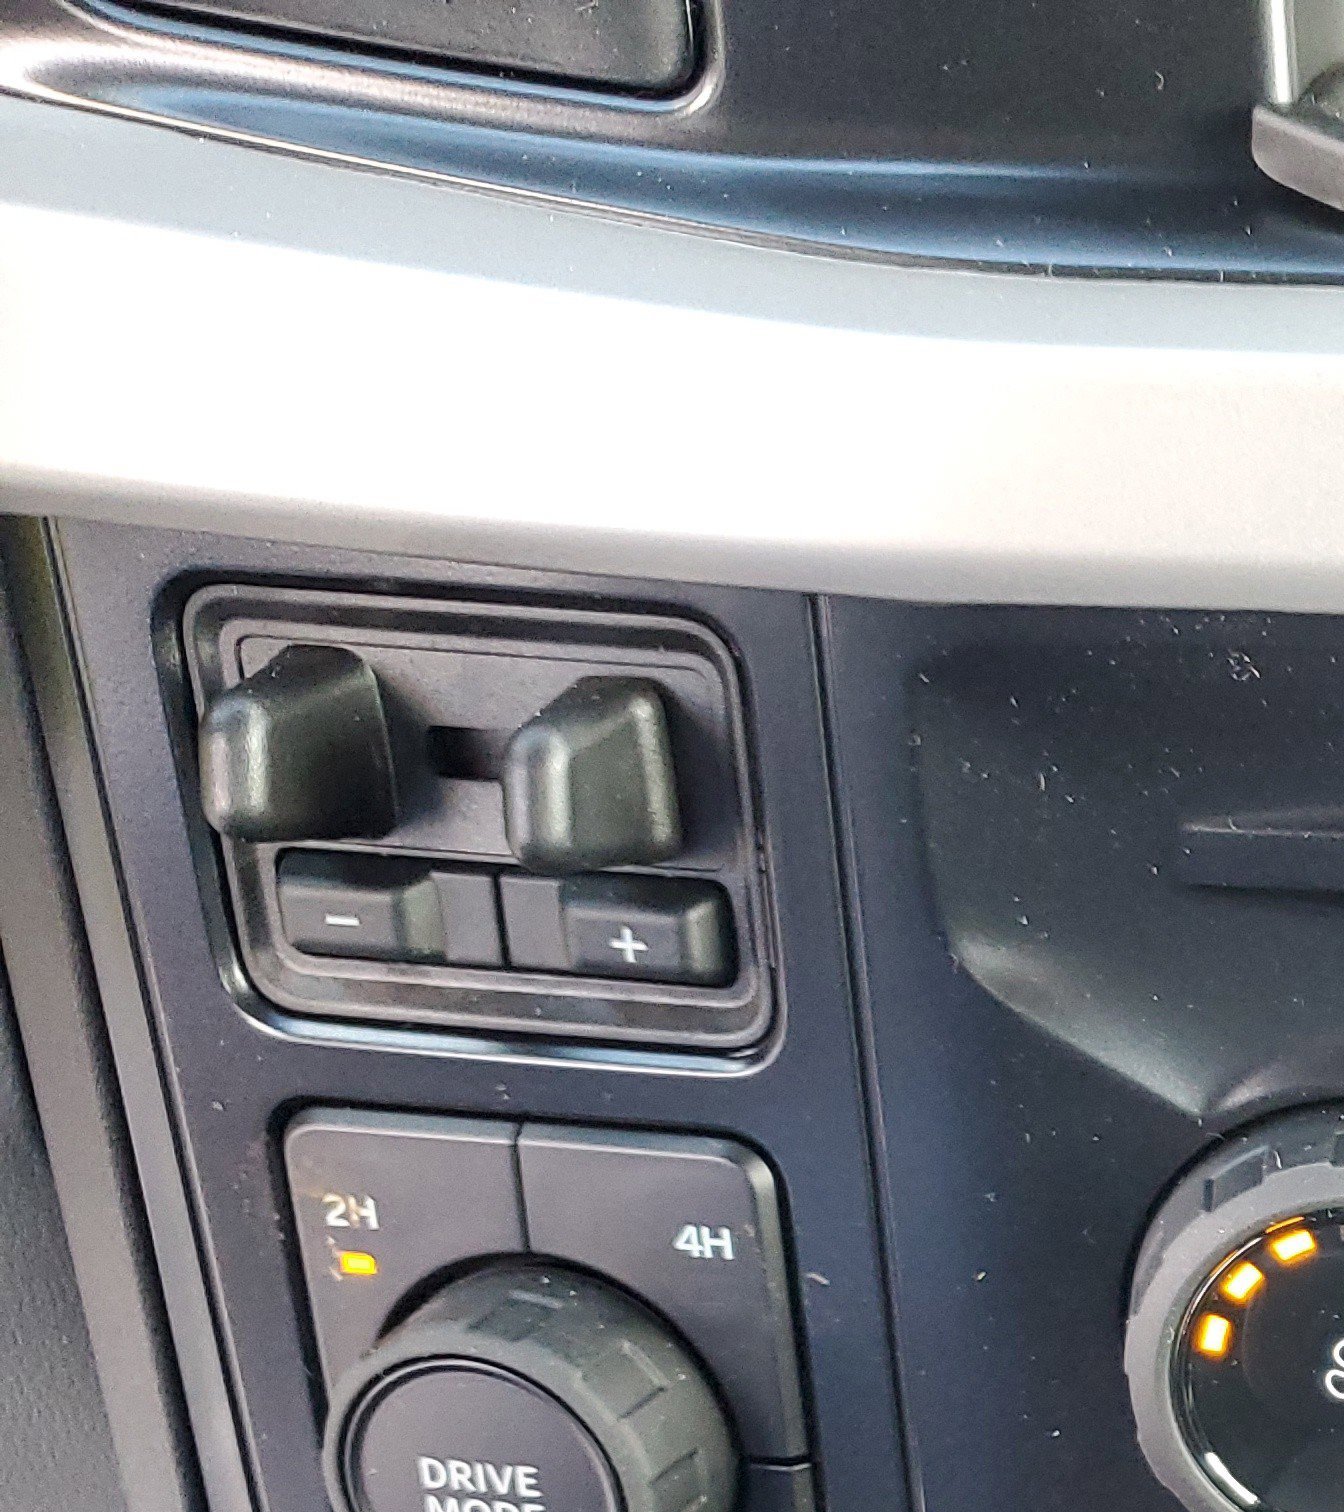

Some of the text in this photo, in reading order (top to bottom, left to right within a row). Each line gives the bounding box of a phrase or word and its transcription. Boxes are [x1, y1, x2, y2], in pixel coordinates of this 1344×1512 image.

[322, 1192, 380, 1231] 2H
[673, 1224, 736, 1262] 4H
[418, 1455, 543, 1498] DRIVE
